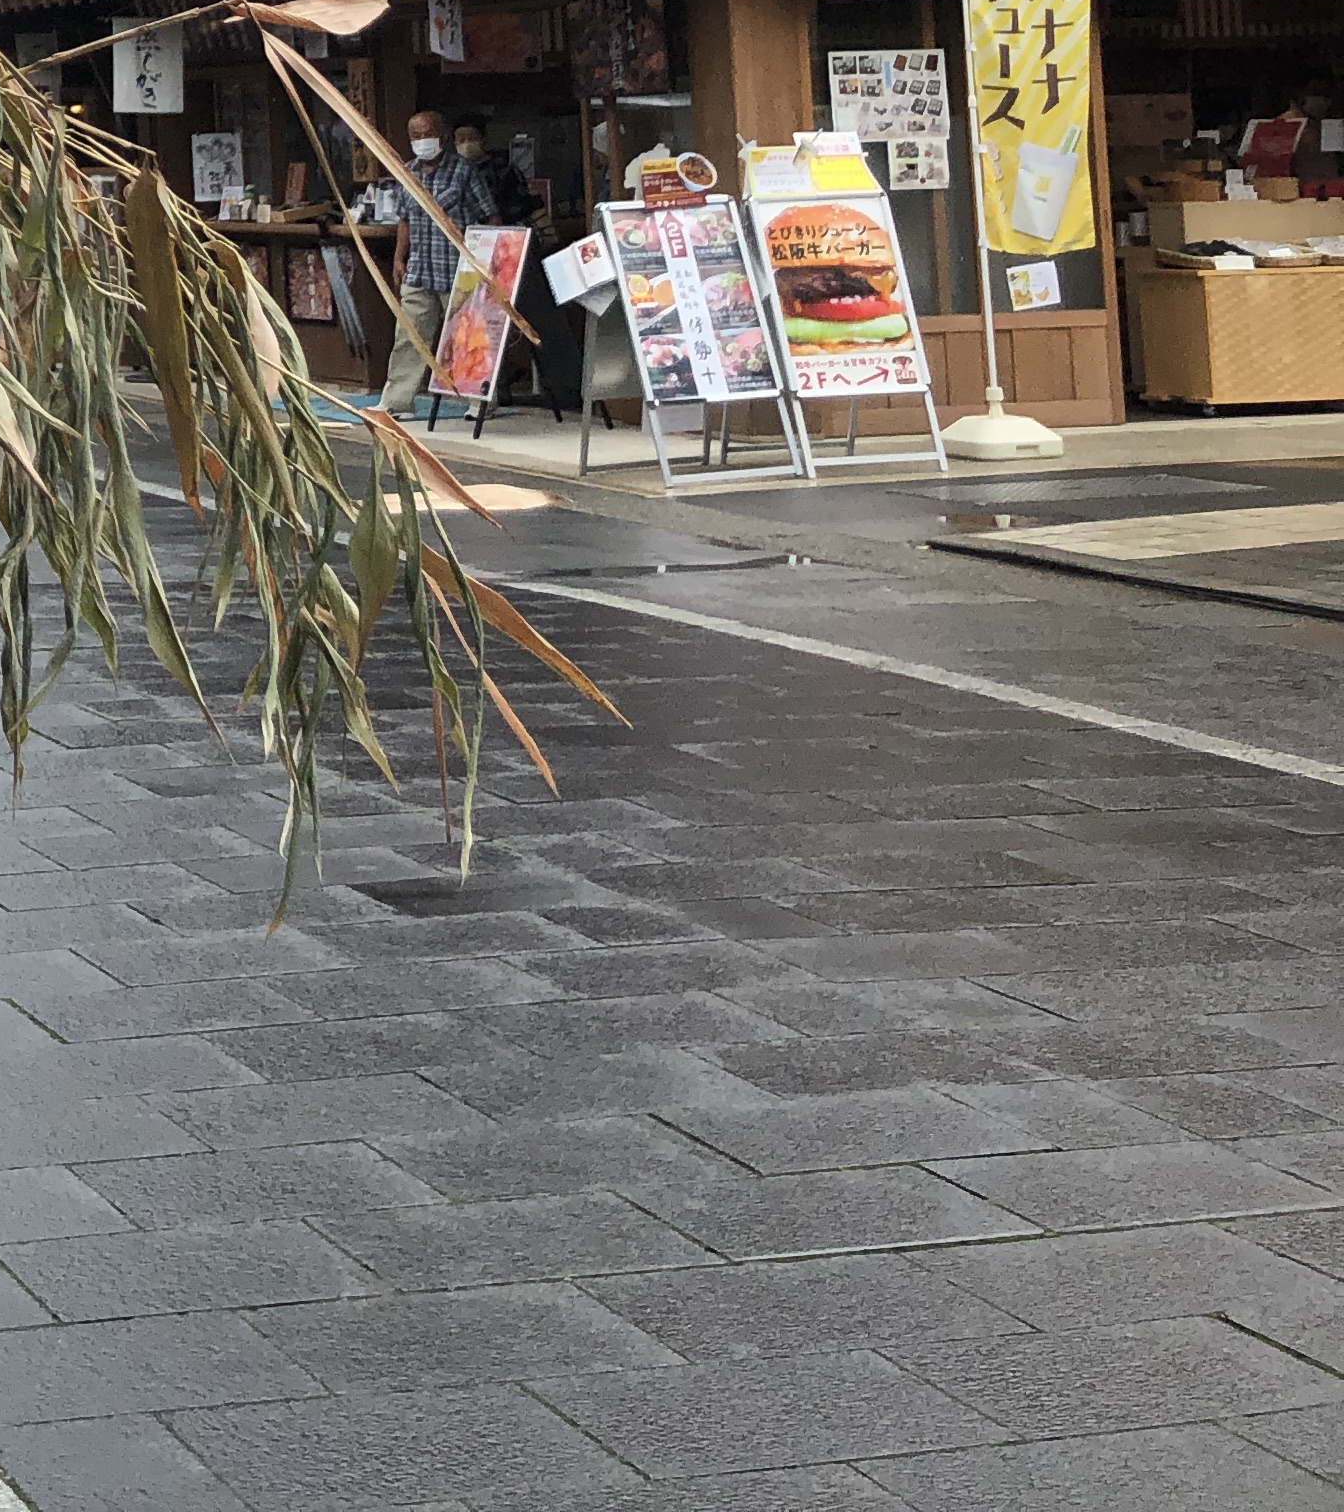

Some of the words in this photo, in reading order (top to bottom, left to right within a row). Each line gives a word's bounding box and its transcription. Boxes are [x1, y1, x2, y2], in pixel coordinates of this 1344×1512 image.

[665, 221, 685, 255] 2F
[767, 222, 880, 240] とびきりジューシー
[771, 240, 886, 261] 松阪牛バーガー
[798, 371, 851, 390] 2Fへ
